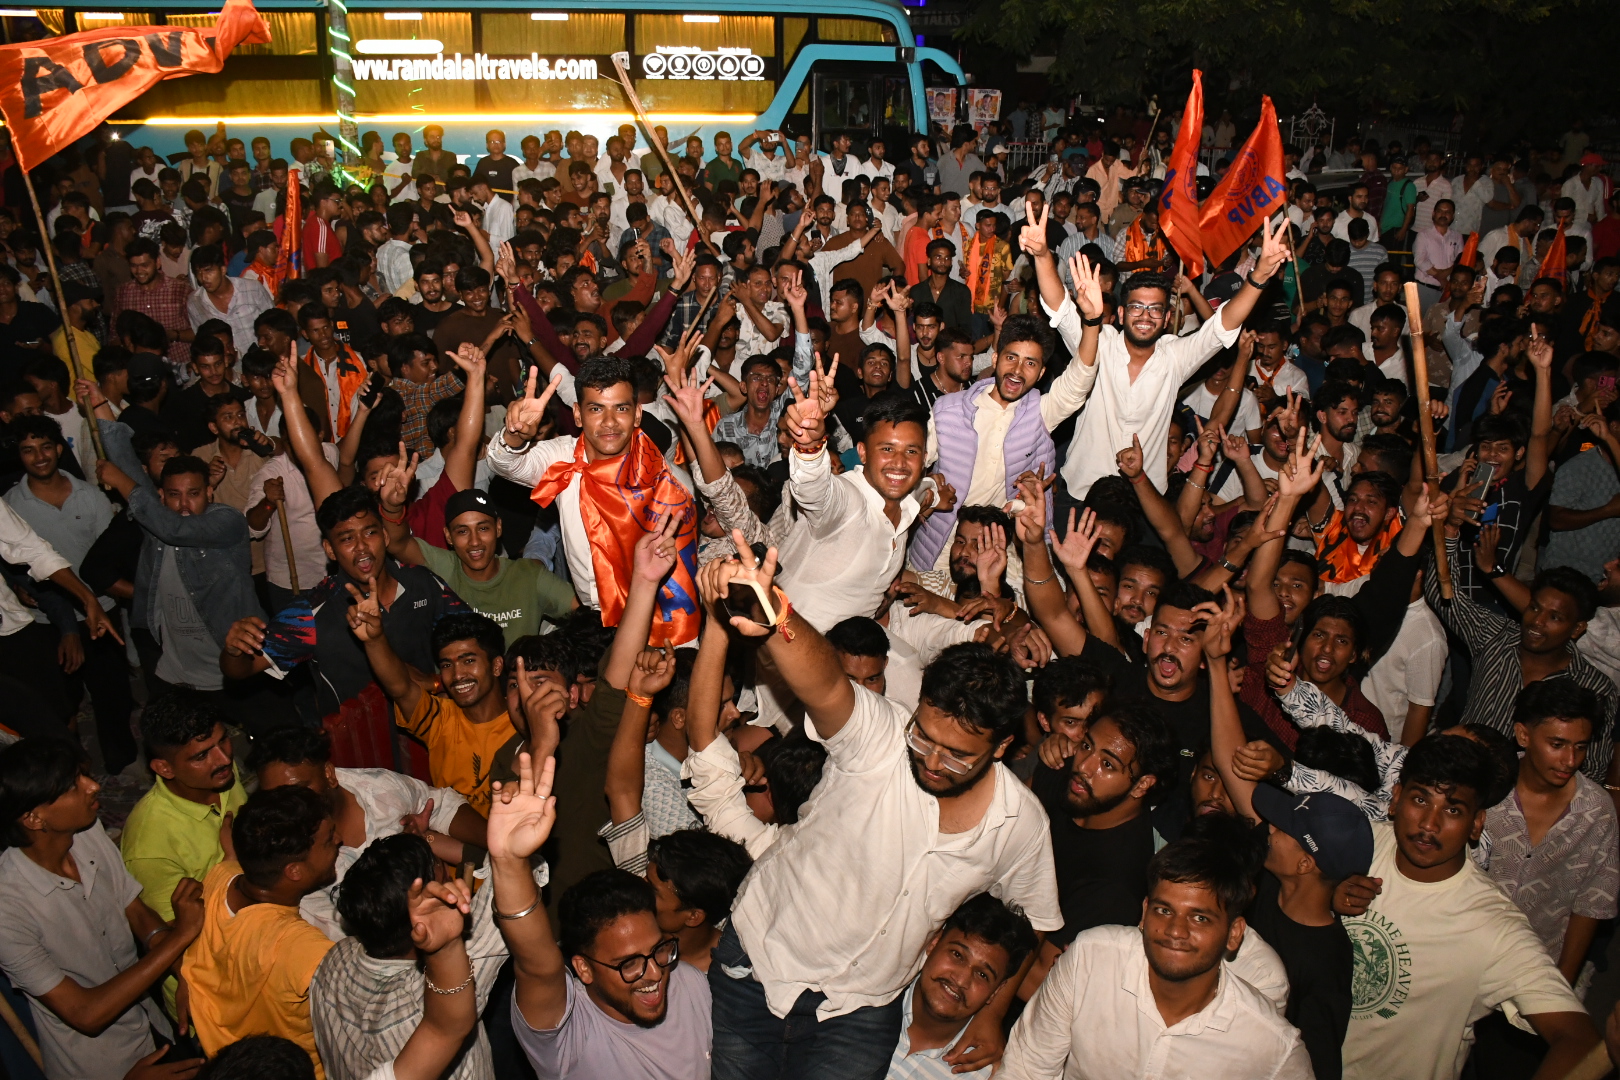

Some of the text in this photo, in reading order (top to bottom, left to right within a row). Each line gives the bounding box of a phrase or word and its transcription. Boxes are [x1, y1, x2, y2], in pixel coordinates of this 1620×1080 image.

[923, 11, 961, 26] TALKS
[979, 253, 991, 285] ABVP
[1303, 833, 1319, 853] PUMA
[1363, 908, 1412, 1009] TIME HEAVEN
[1359, 1013, 1374, 1021] LIFE
